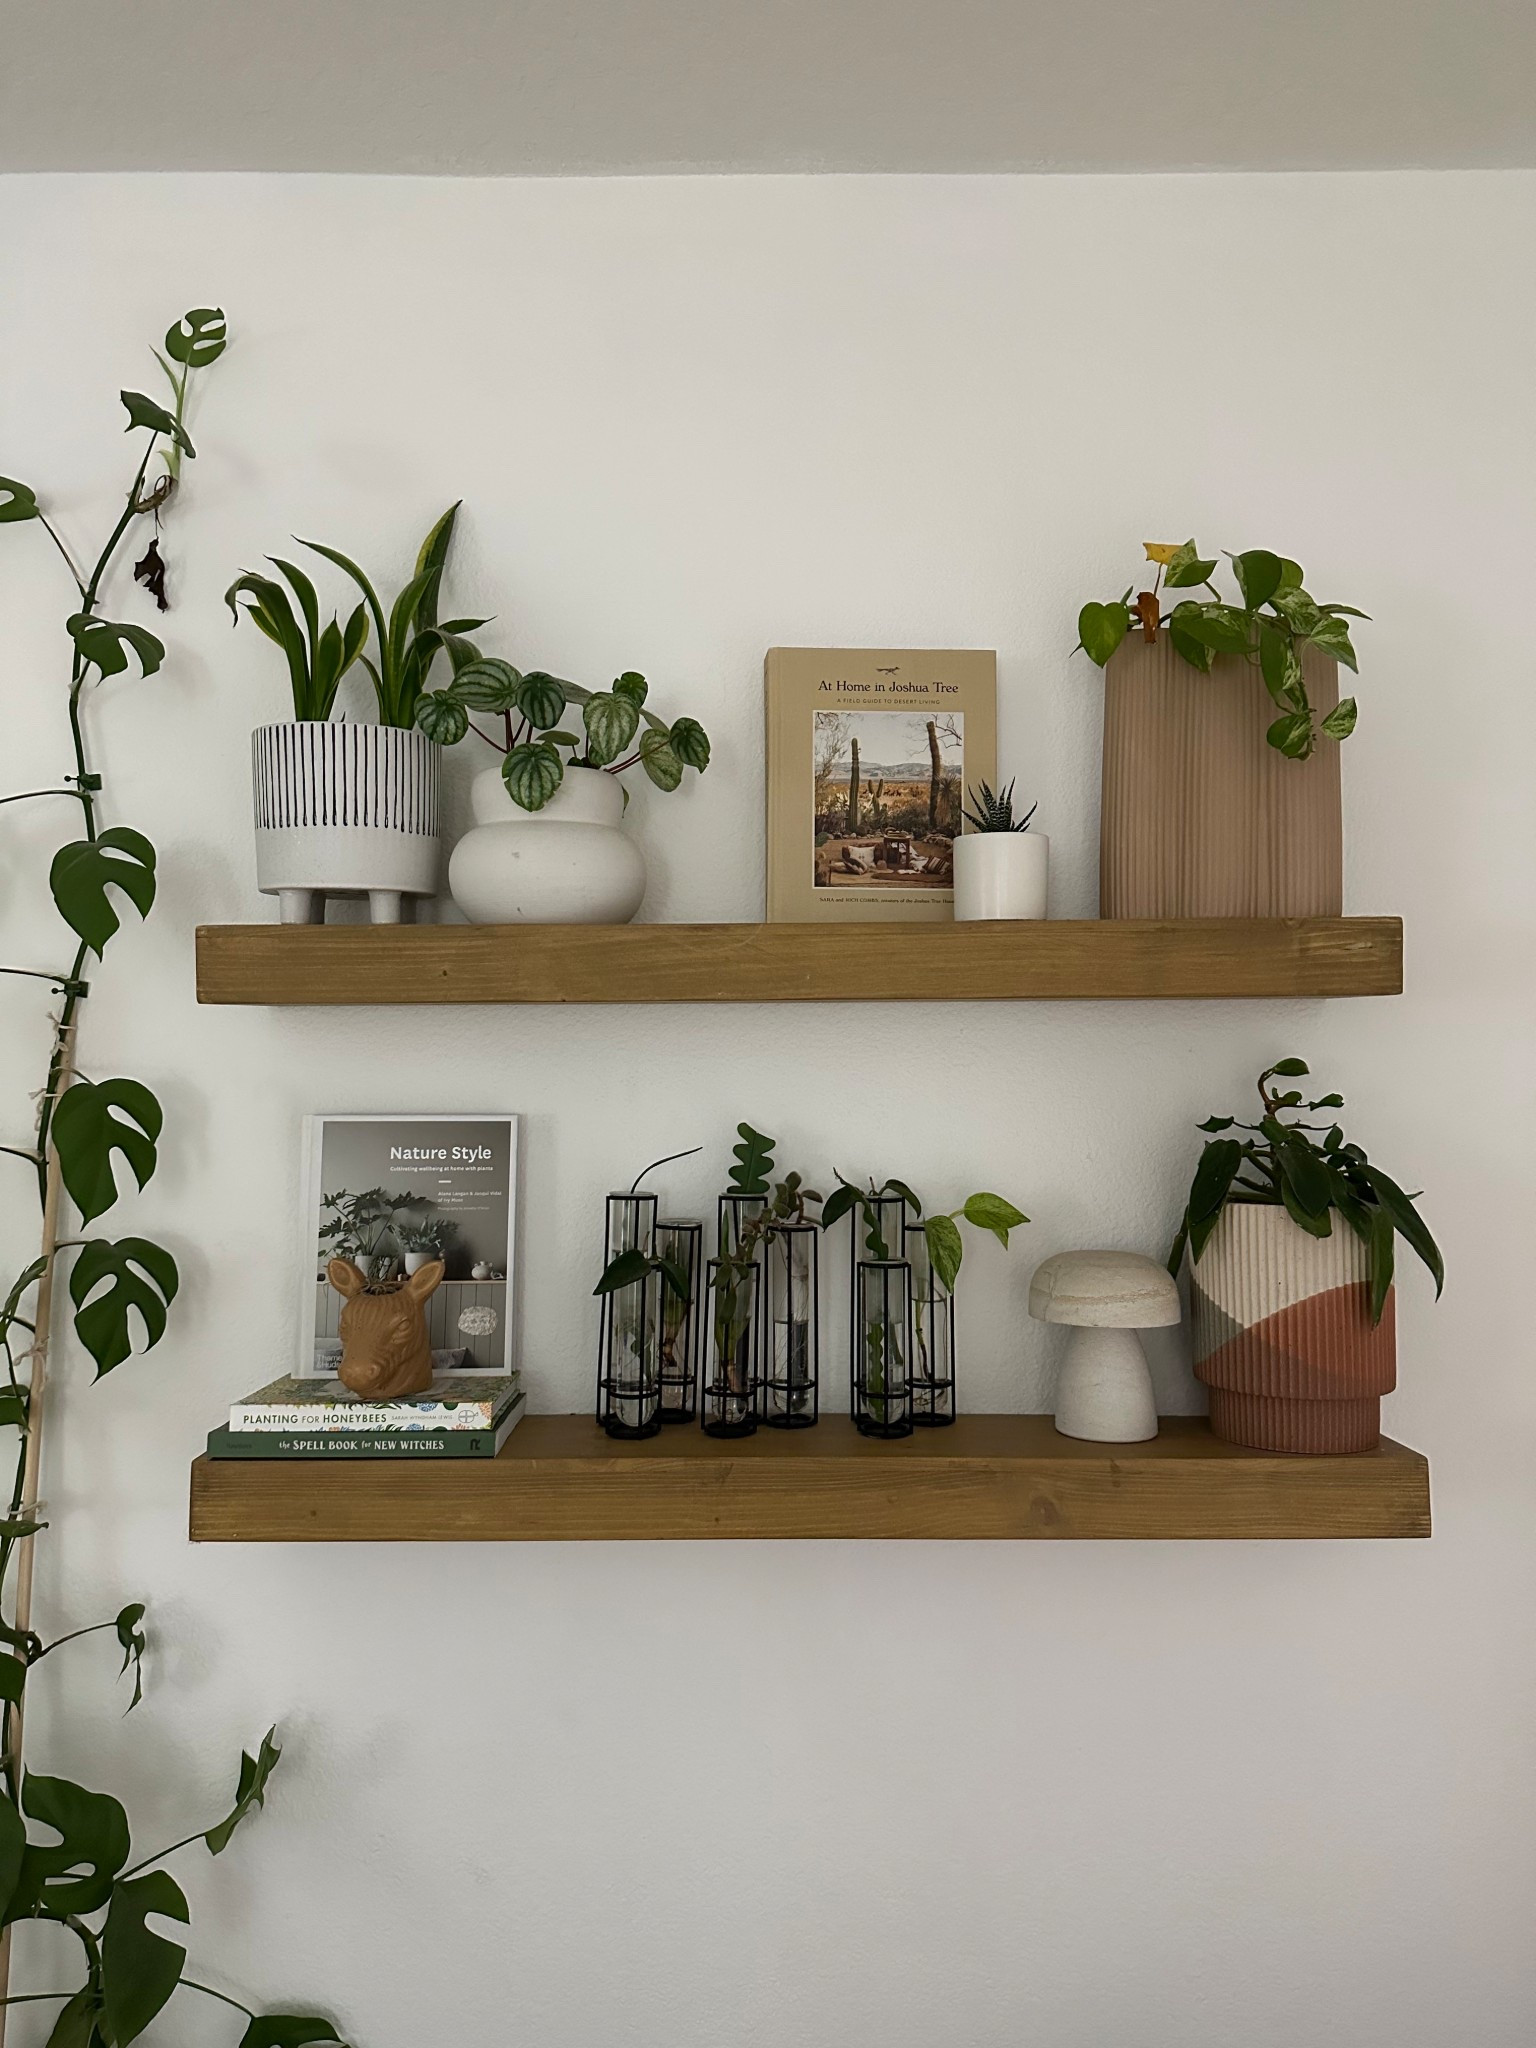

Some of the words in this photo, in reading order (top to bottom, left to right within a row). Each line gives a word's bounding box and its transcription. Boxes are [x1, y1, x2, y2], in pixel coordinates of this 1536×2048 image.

[818, 680, 832, 691] At
[836, 680, 871, 692] Home
[875, 681, 885, 692] in
[889, 681, 929, 693] Joshua
[933, 682, 959, 693] Tree
[390, 1146, 447, 1160] Nature
[452, 1145, 492, 1163] Style
[243, 1414, 298, 1424] PLANTING
[301, 1415, 320, 1423] FOR
[323, 1414, 387, 1424] HONEYBEES
[279, 1440, 290, 1449] the
[293, 1440, 326, 1450] SPELL
[328, 1440, 358, 1450] BOOK
[361, 1440, 371, 1449] for
[374, 1440, 397, 1450] NEW
[400, 1440, 445, 1450] WITCHES
